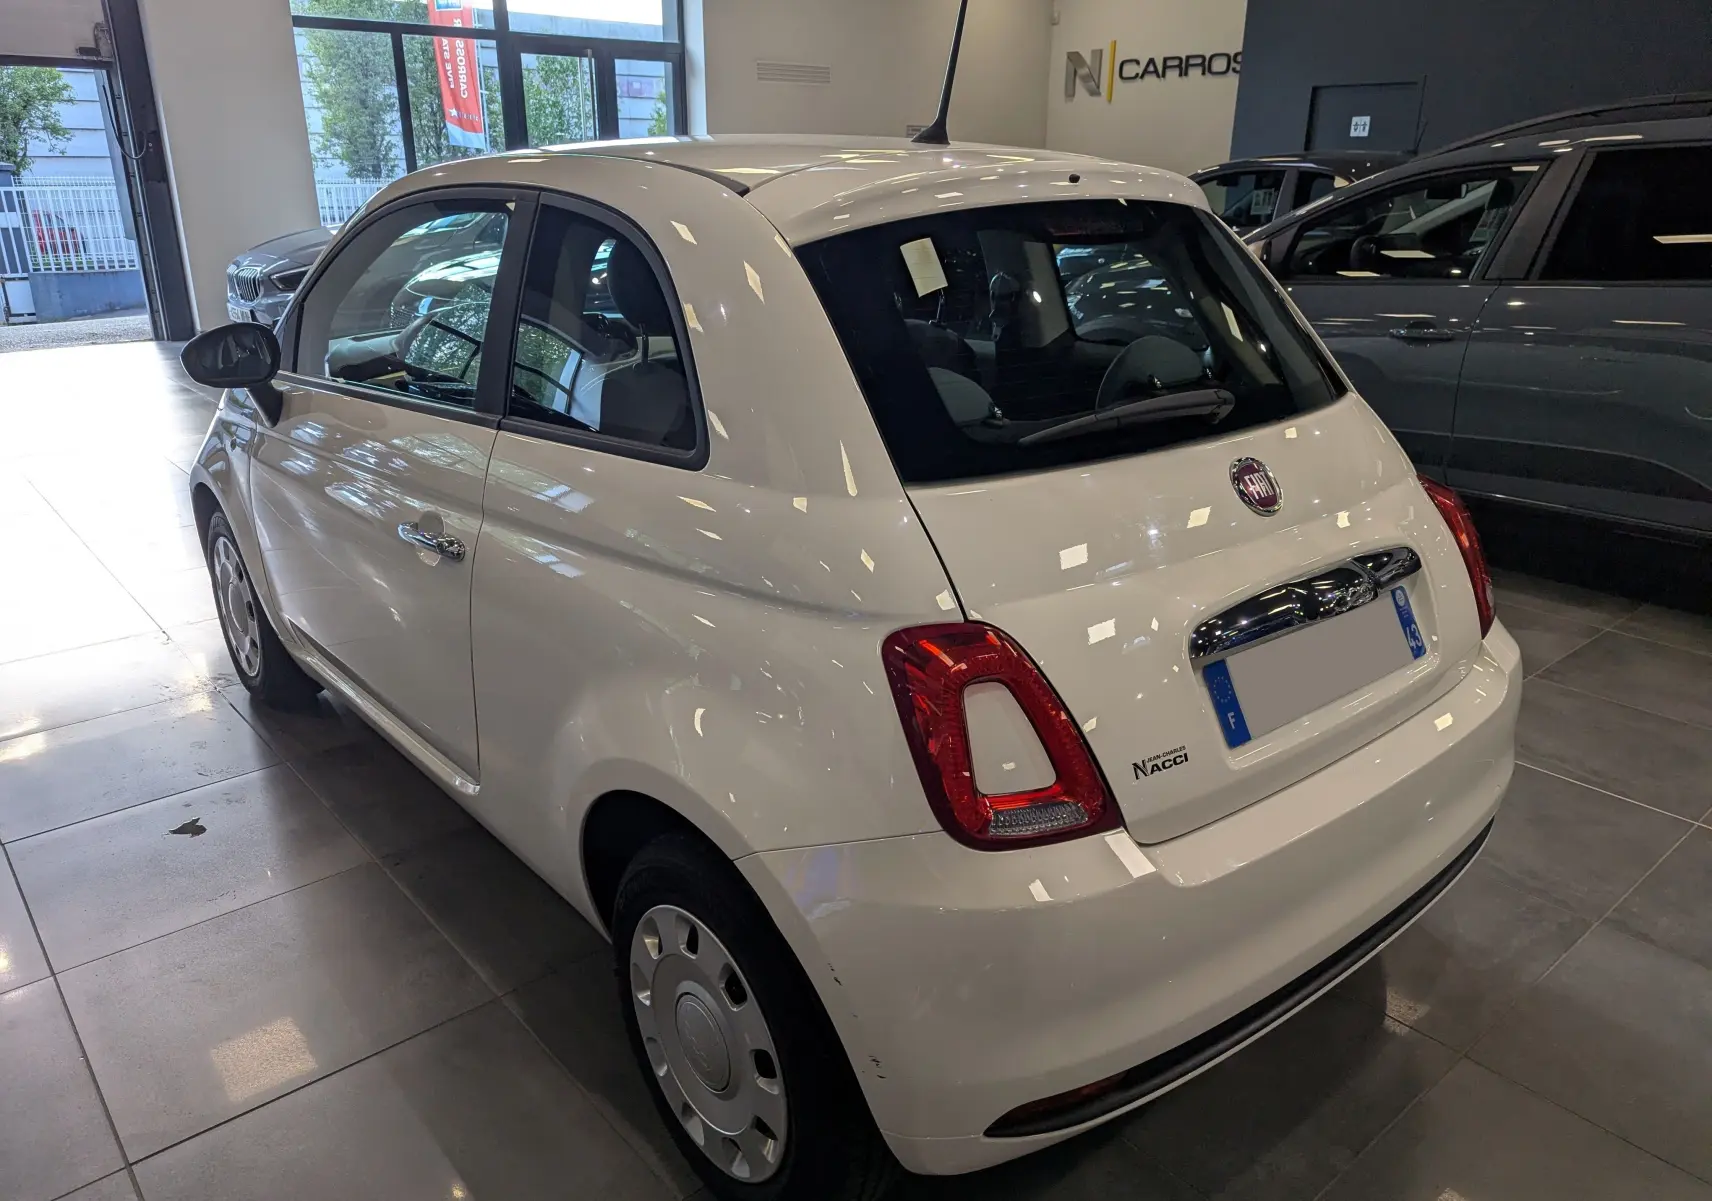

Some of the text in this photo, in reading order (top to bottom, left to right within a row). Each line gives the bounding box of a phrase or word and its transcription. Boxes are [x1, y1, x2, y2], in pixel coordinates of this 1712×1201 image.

[1244, 471, 1275, 500] FIAT
[1406, 623, 1423, 649] 43
[1227, 711, 1236, 729] F
[1132, 752, 1189, 781] NACCI
[1146, 745, 1187, 763] JEAN-CHARLES
